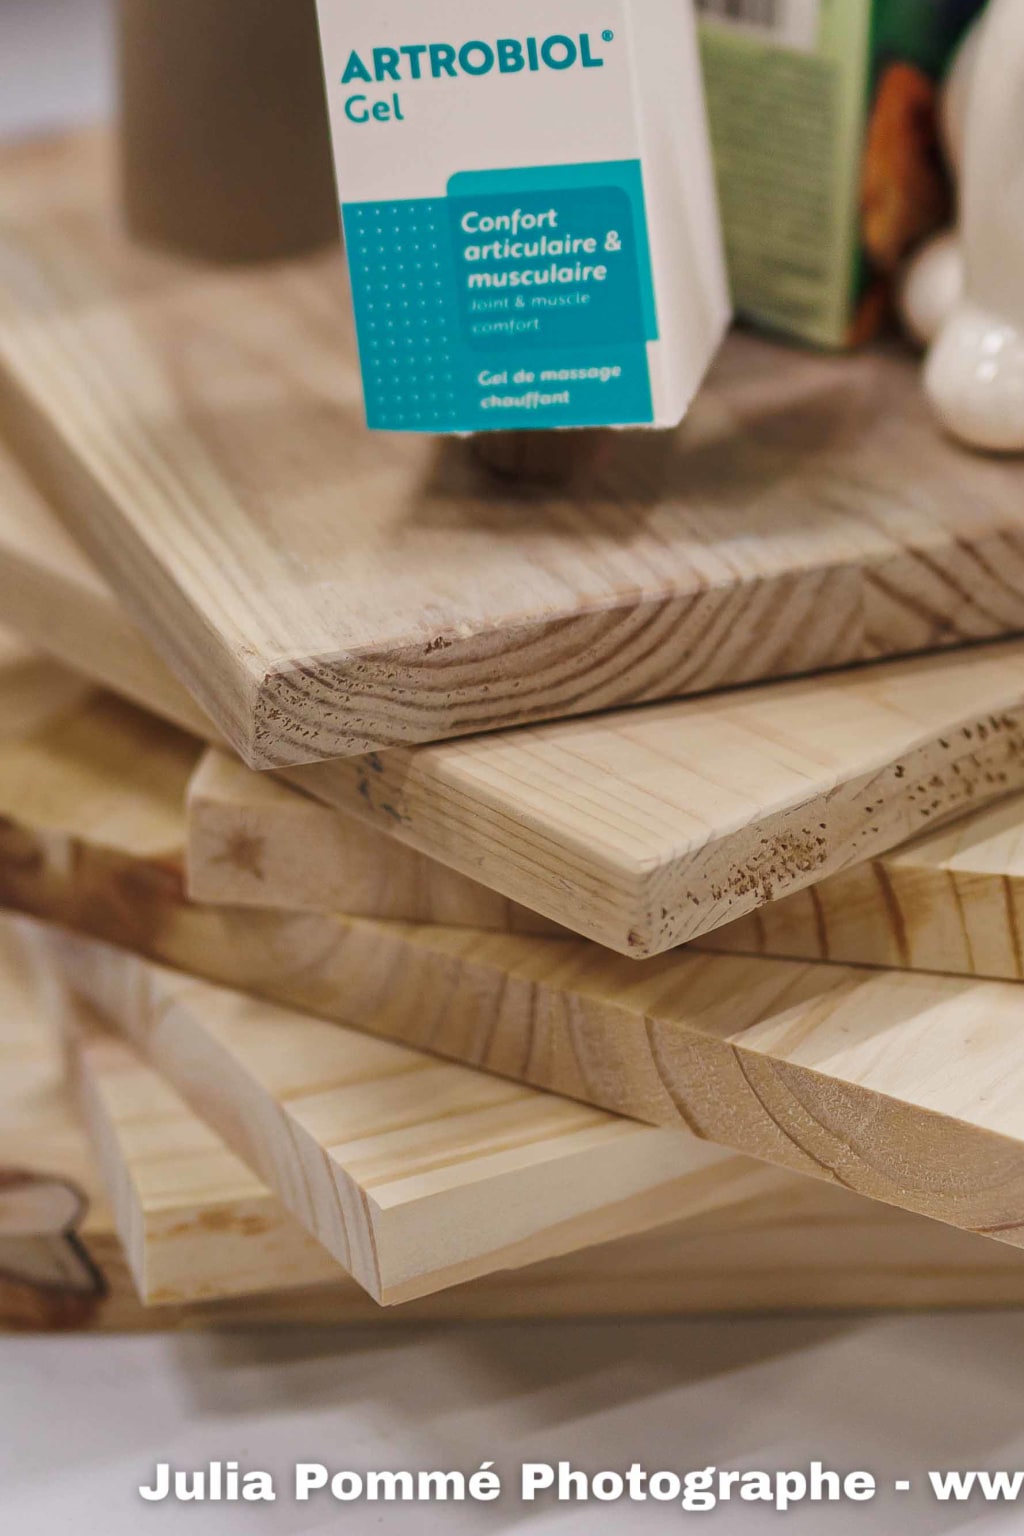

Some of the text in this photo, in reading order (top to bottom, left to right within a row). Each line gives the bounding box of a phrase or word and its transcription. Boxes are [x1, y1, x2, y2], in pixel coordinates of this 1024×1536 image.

[344, 93, 404, 123] Gel
[461, 208, 558, 235] Confort
[464, 230, 622, 261] articulaire &
[468, 261, 607, 289] musculaire
[514, 295, 525, 308] &
[531, 292, 591, 307] muscle
[473, 317, 540, 335] comfort
[478, 366, 621, 386] Gel de massage
[480, 390, 569, 409] chauffant
